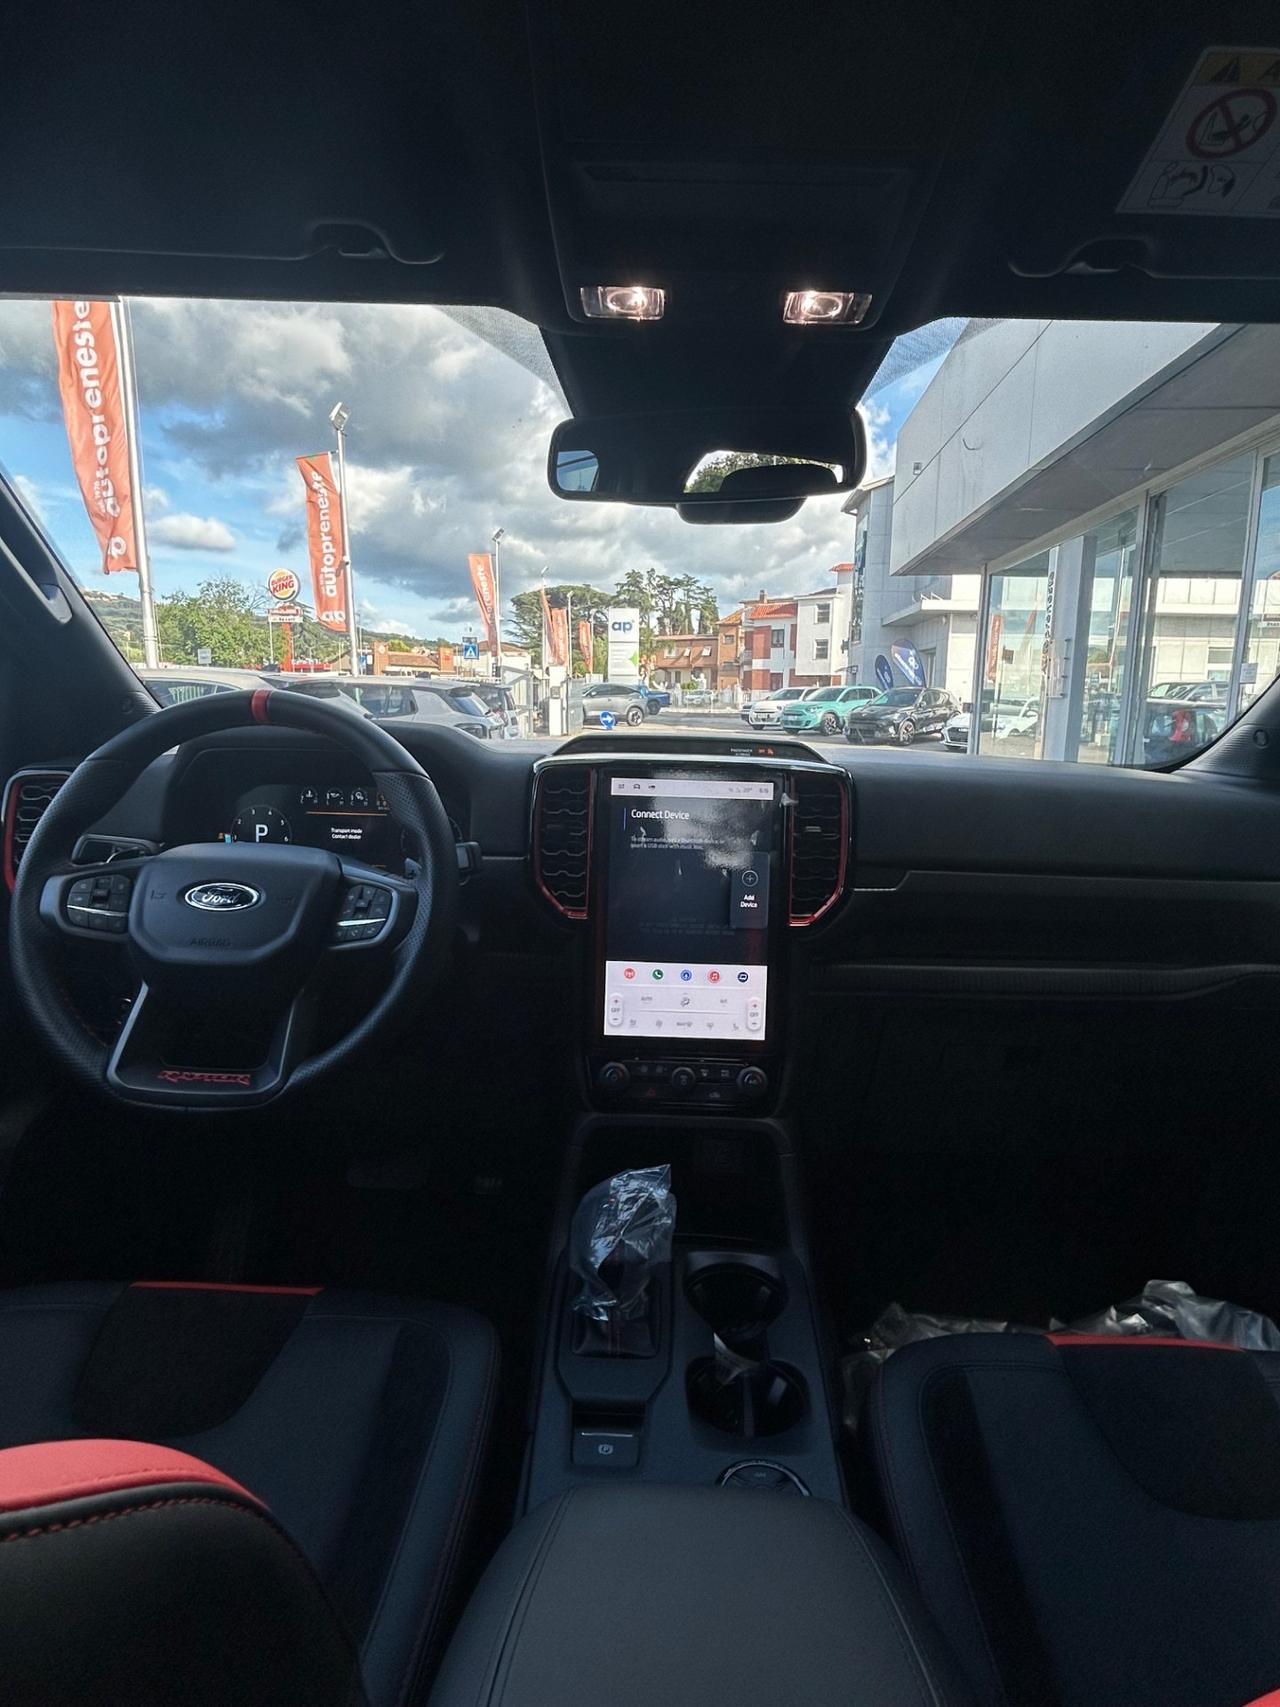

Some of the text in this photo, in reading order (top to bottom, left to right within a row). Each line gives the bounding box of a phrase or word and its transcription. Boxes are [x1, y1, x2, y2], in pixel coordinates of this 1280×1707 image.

[312, 471, 337, 597] autopreneste
[272, 580, 295, 593] KING
[611, 621, 633, 633] ap
[631, 809, 690, 820] Connect Device
[255, 823, 269, 843] P
[200, 887, 241, 904] Ford
